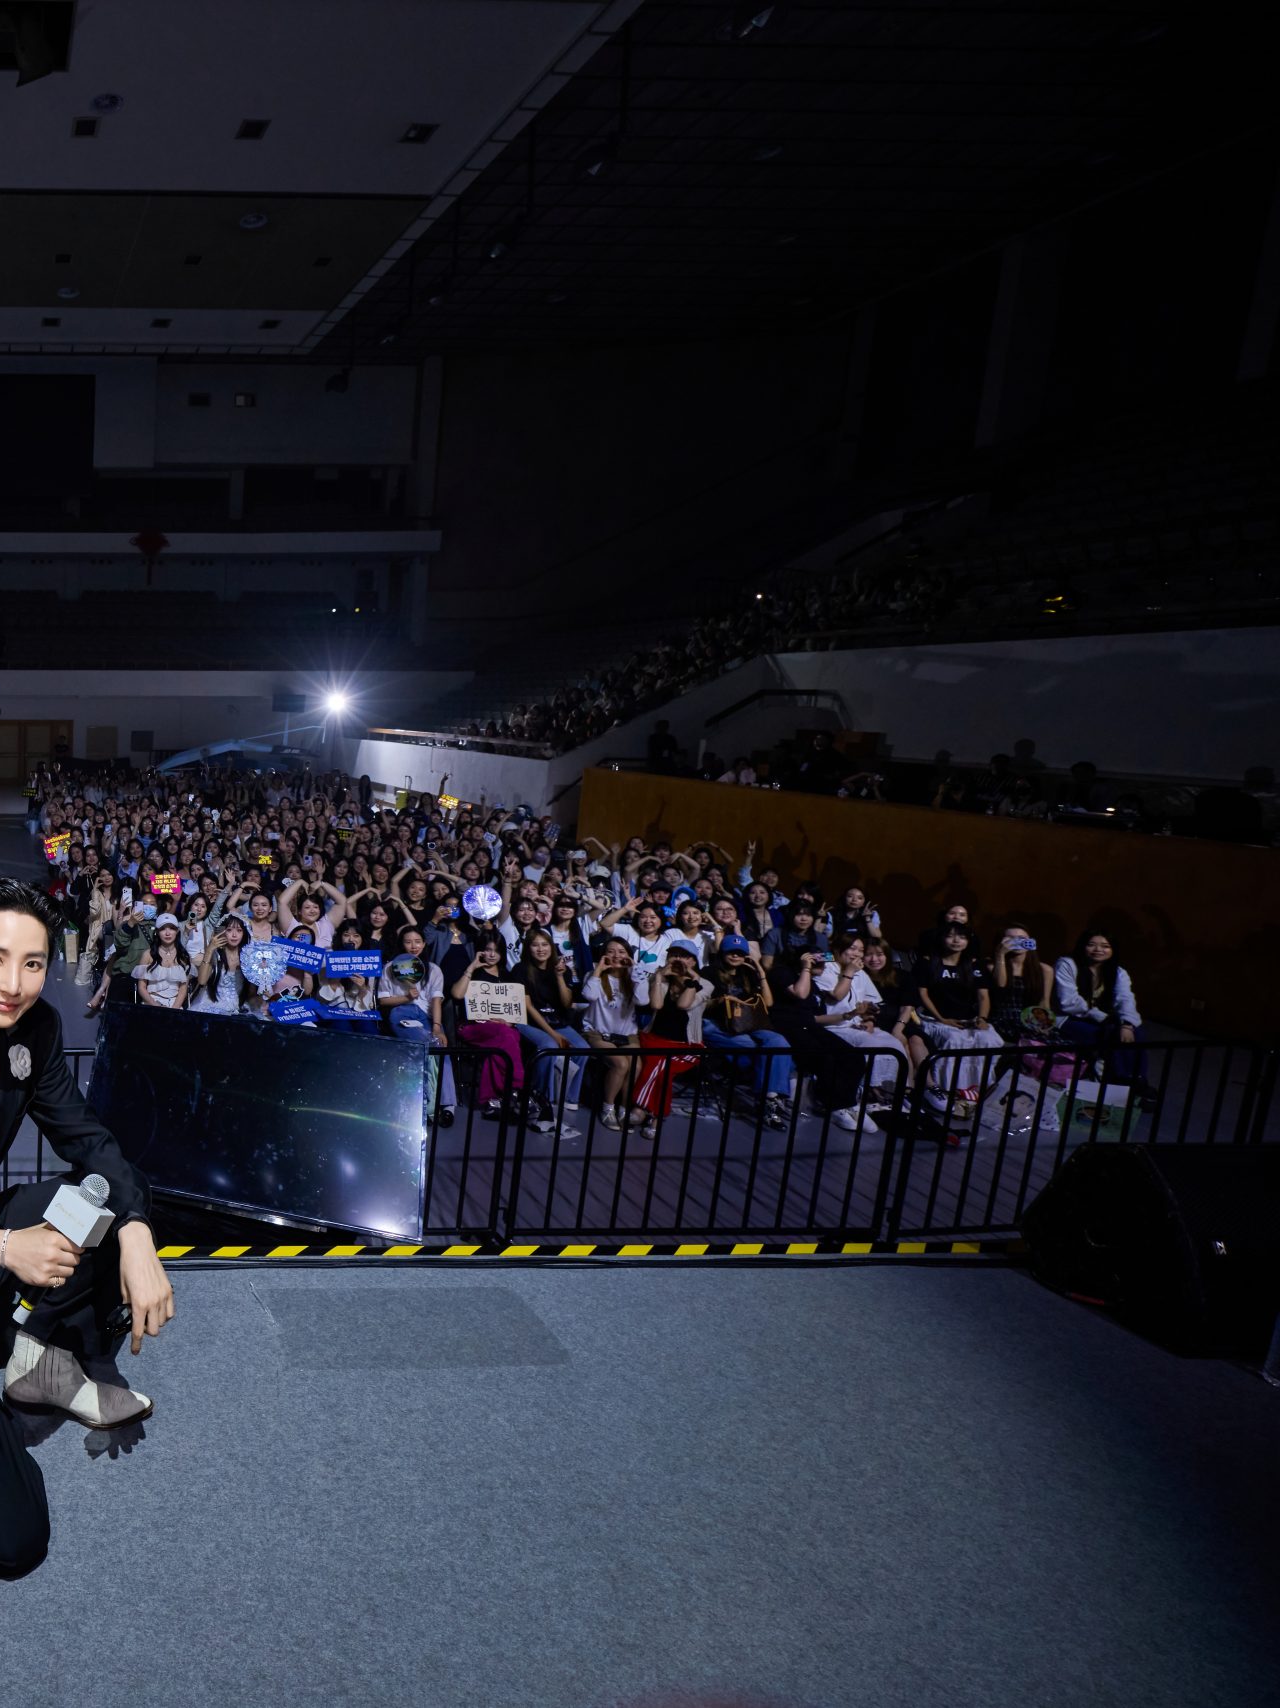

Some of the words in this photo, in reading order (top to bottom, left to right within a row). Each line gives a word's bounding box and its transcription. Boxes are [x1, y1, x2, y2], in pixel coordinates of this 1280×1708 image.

[291, 953, 314, 965] 기억할게
[295, 947, 306, 956] 모든
[306, 950, 323, 960] 순간을
[350, 963, 373, 971] 기억할게
[480, 982, 509, 997] 오빠
[468, 998, 479, 1013] 볼
